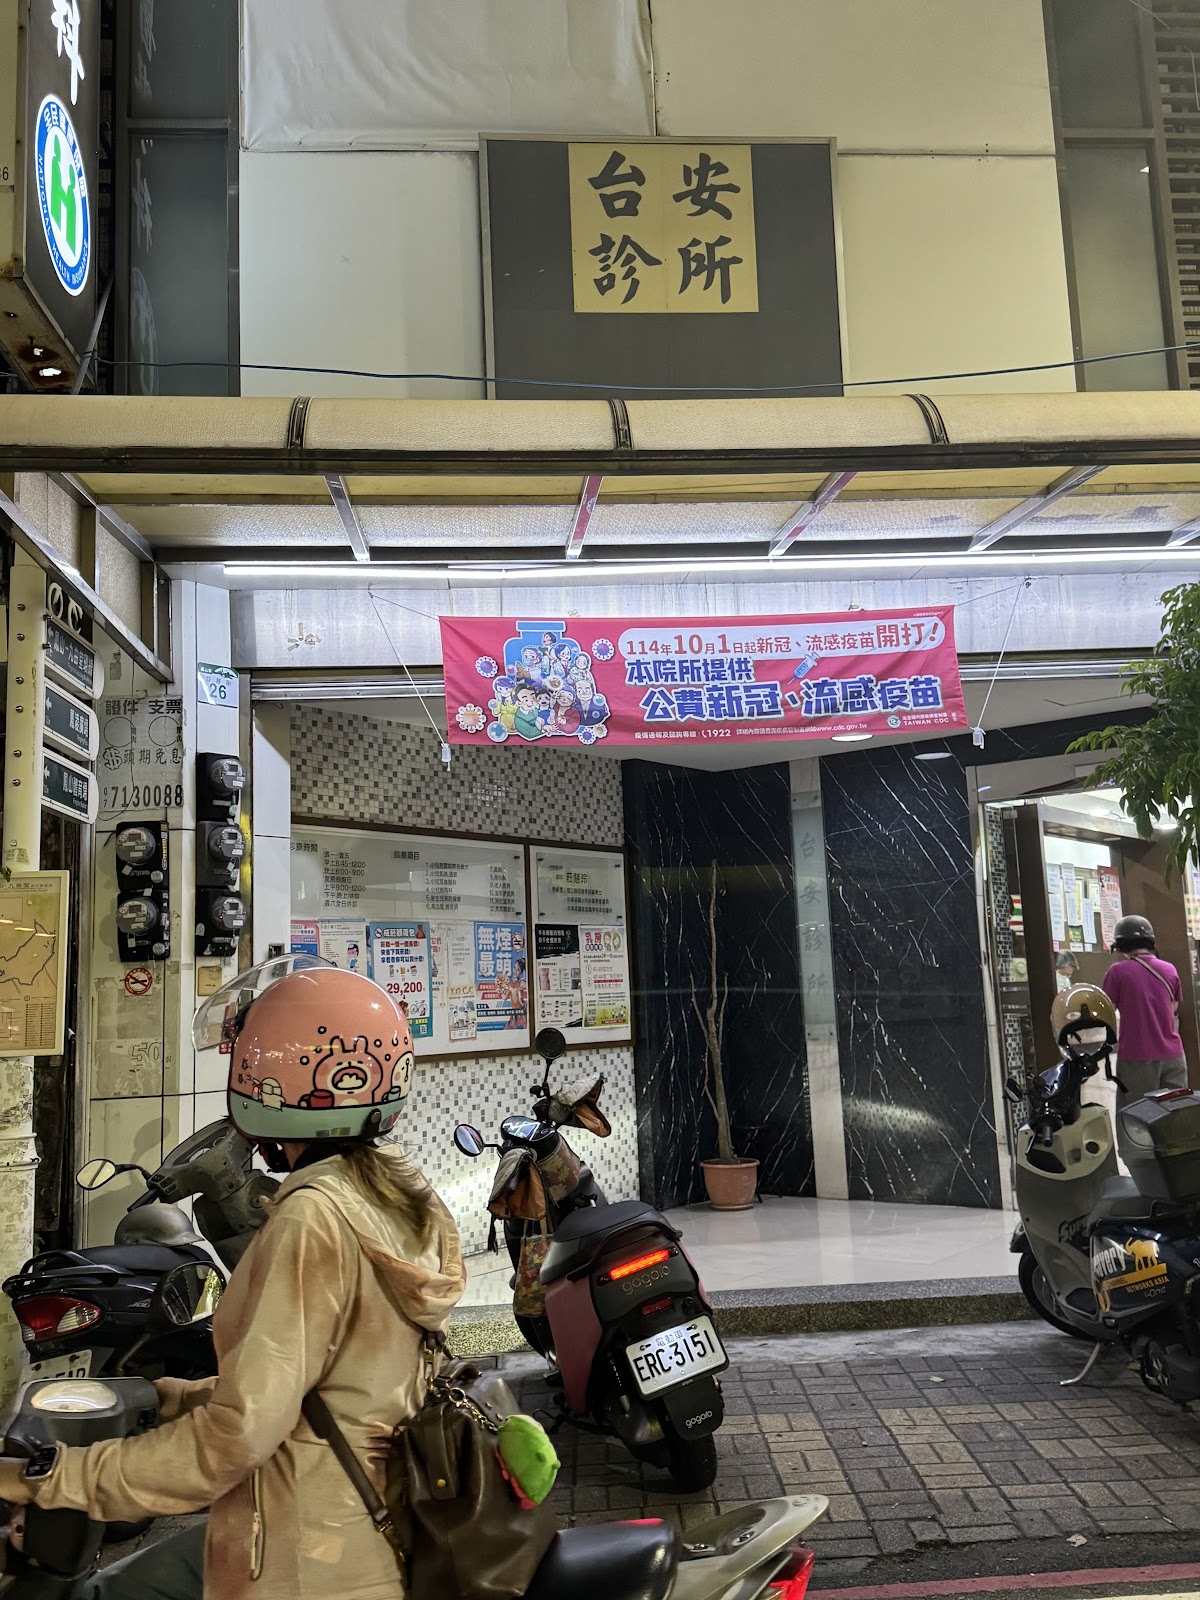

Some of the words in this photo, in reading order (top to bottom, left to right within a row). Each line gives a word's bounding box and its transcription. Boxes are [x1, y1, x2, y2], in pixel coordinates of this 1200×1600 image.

[588, 150, 741, 220] 台安
[588, 232, 743, 305] 診所
[625, 656, 754, 685] 本院所提供
[209, 682, 227, 700] 26
[640, 674, 943, 723] 公費新冠、流感疫苗
[105, 700, 138, 716] 證件
[149, 699, 182, 715] 支票
[707, 729, 732, 738] 1922
[111, 784, 183, 808] 7130088
[386, 981, 423, 996] 29,200
[1126, 1280, 1154, 1293] NETWORKS
[1154, 1276, 1169, 1287] ASIA
[685, 1410, 713, 1429] gogoro
